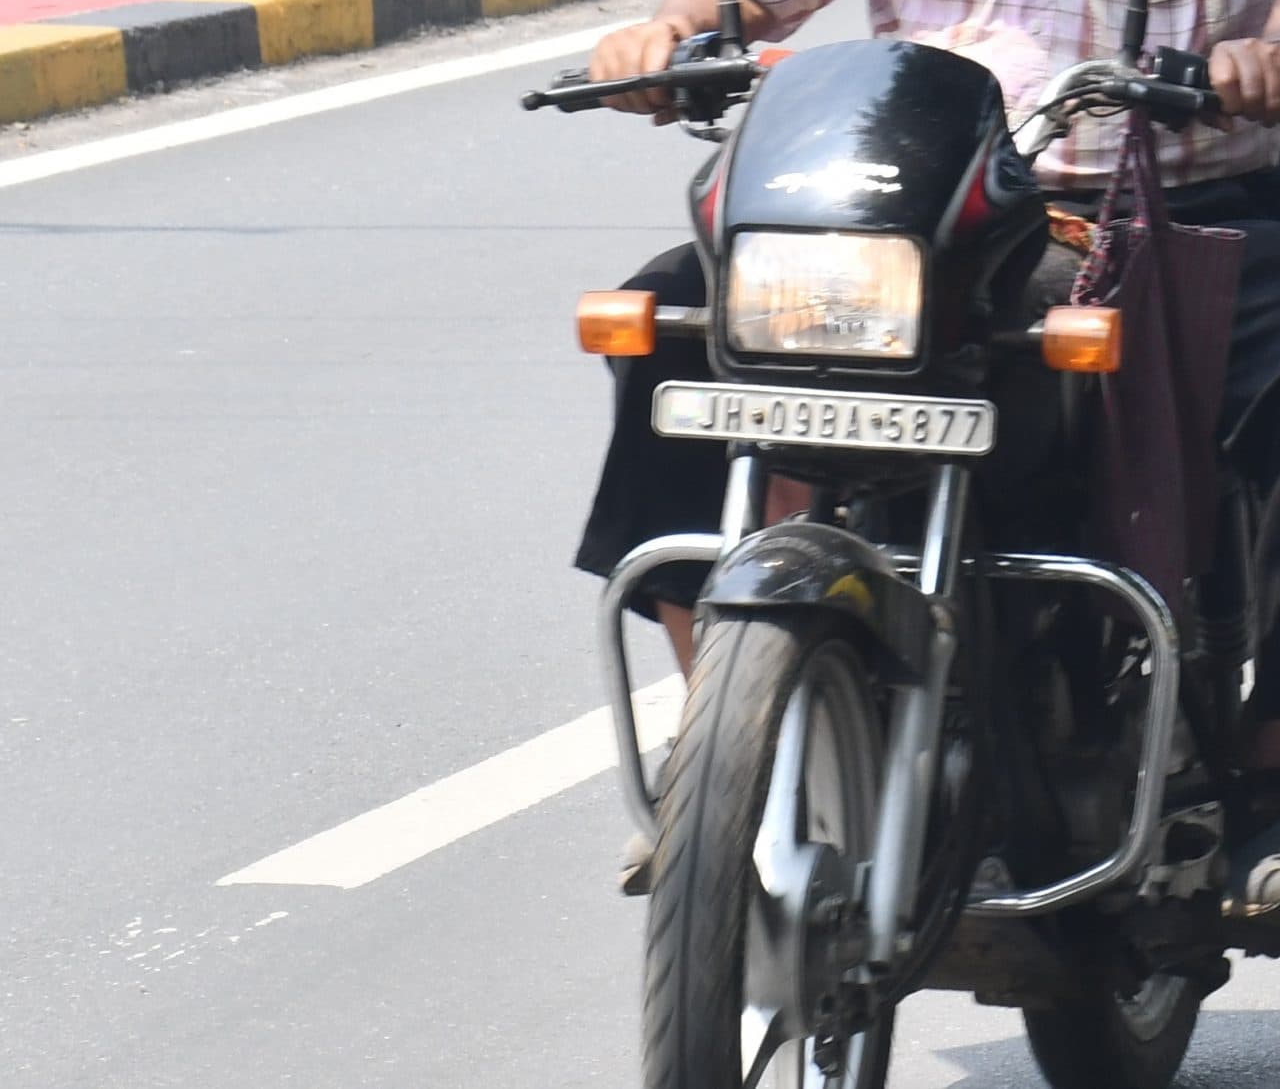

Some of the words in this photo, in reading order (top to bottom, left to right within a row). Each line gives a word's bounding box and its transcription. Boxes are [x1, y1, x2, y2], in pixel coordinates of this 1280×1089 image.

[698, 393, 744, 433] JH
[771, 398, 861, 441] 09BA
[882, 406, 981, 445] 5877
